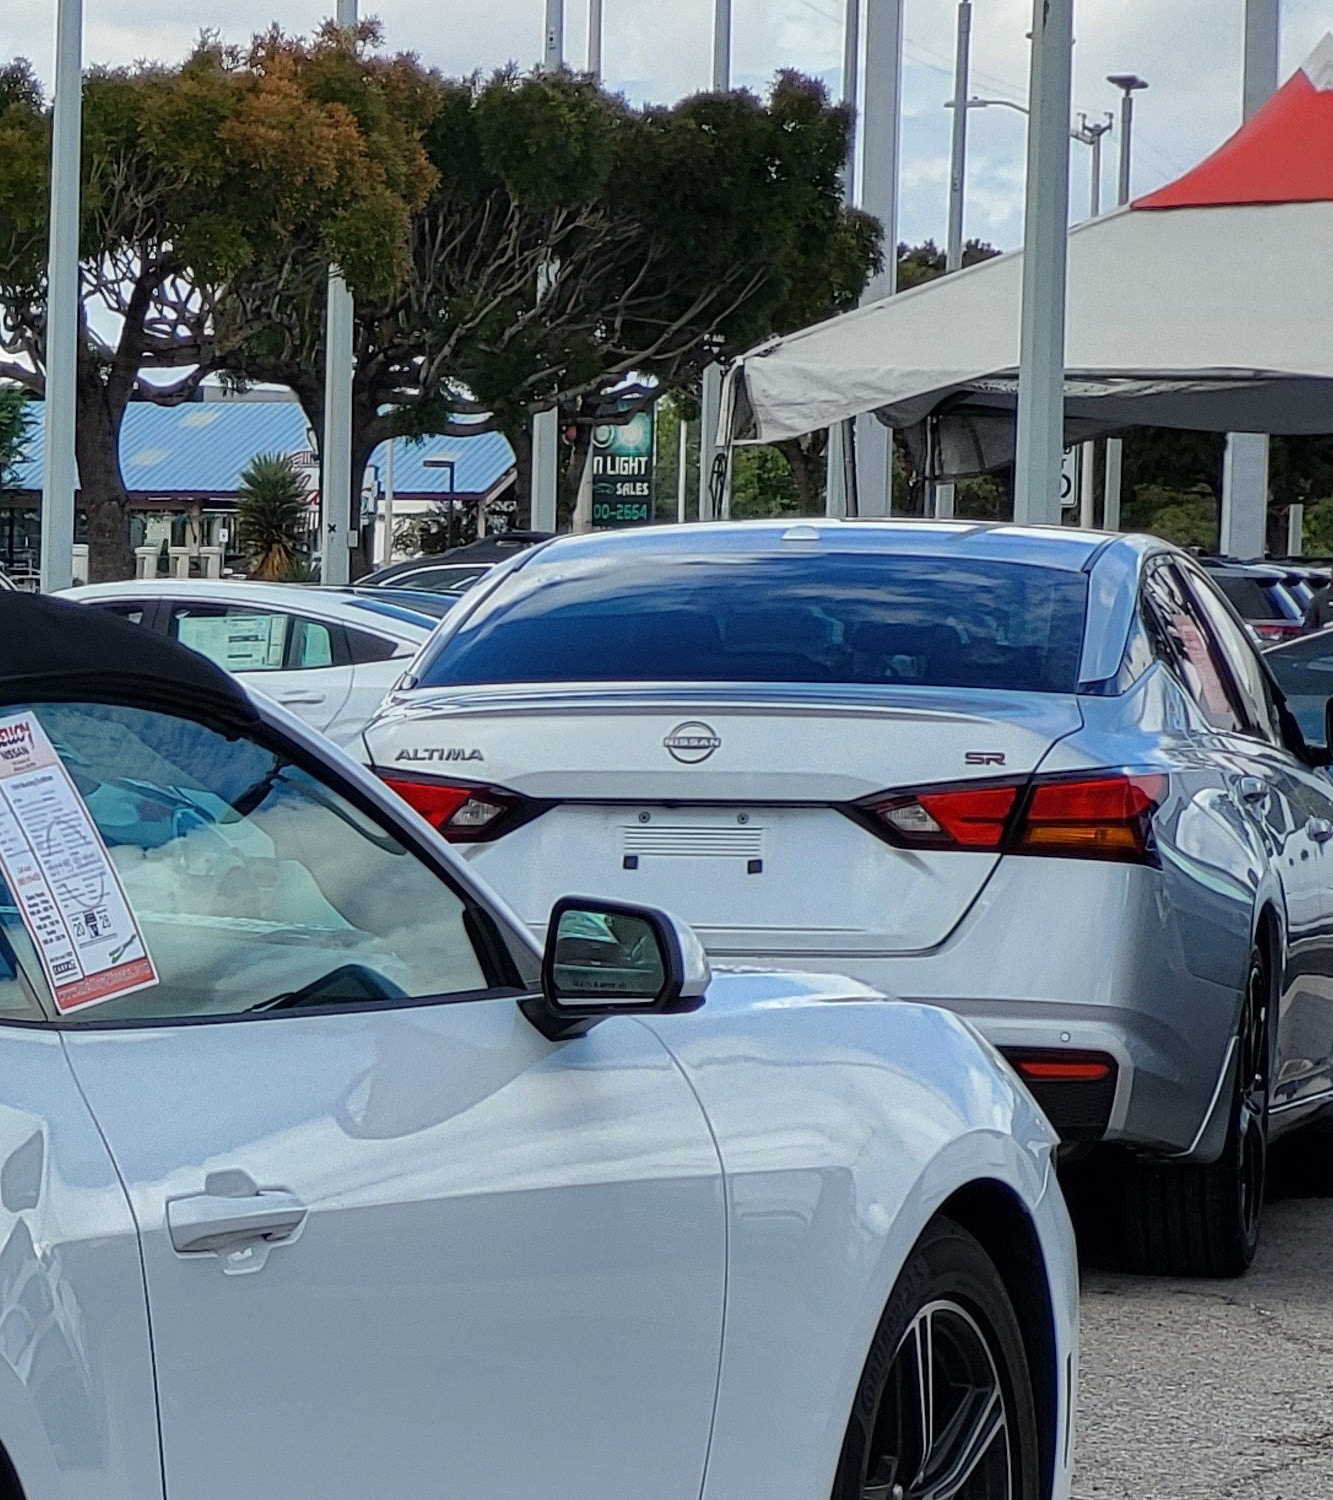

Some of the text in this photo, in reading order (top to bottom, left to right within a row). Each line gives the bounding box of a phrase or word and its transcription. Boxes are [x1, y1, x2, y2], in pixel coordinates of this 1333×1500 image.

[606, 456, 649, 475] LIGHT
[616, 482, 650, 496] SALES
[394, 748, 484, 761] ALTIMA
[965, 752, 1006, 766] SR
